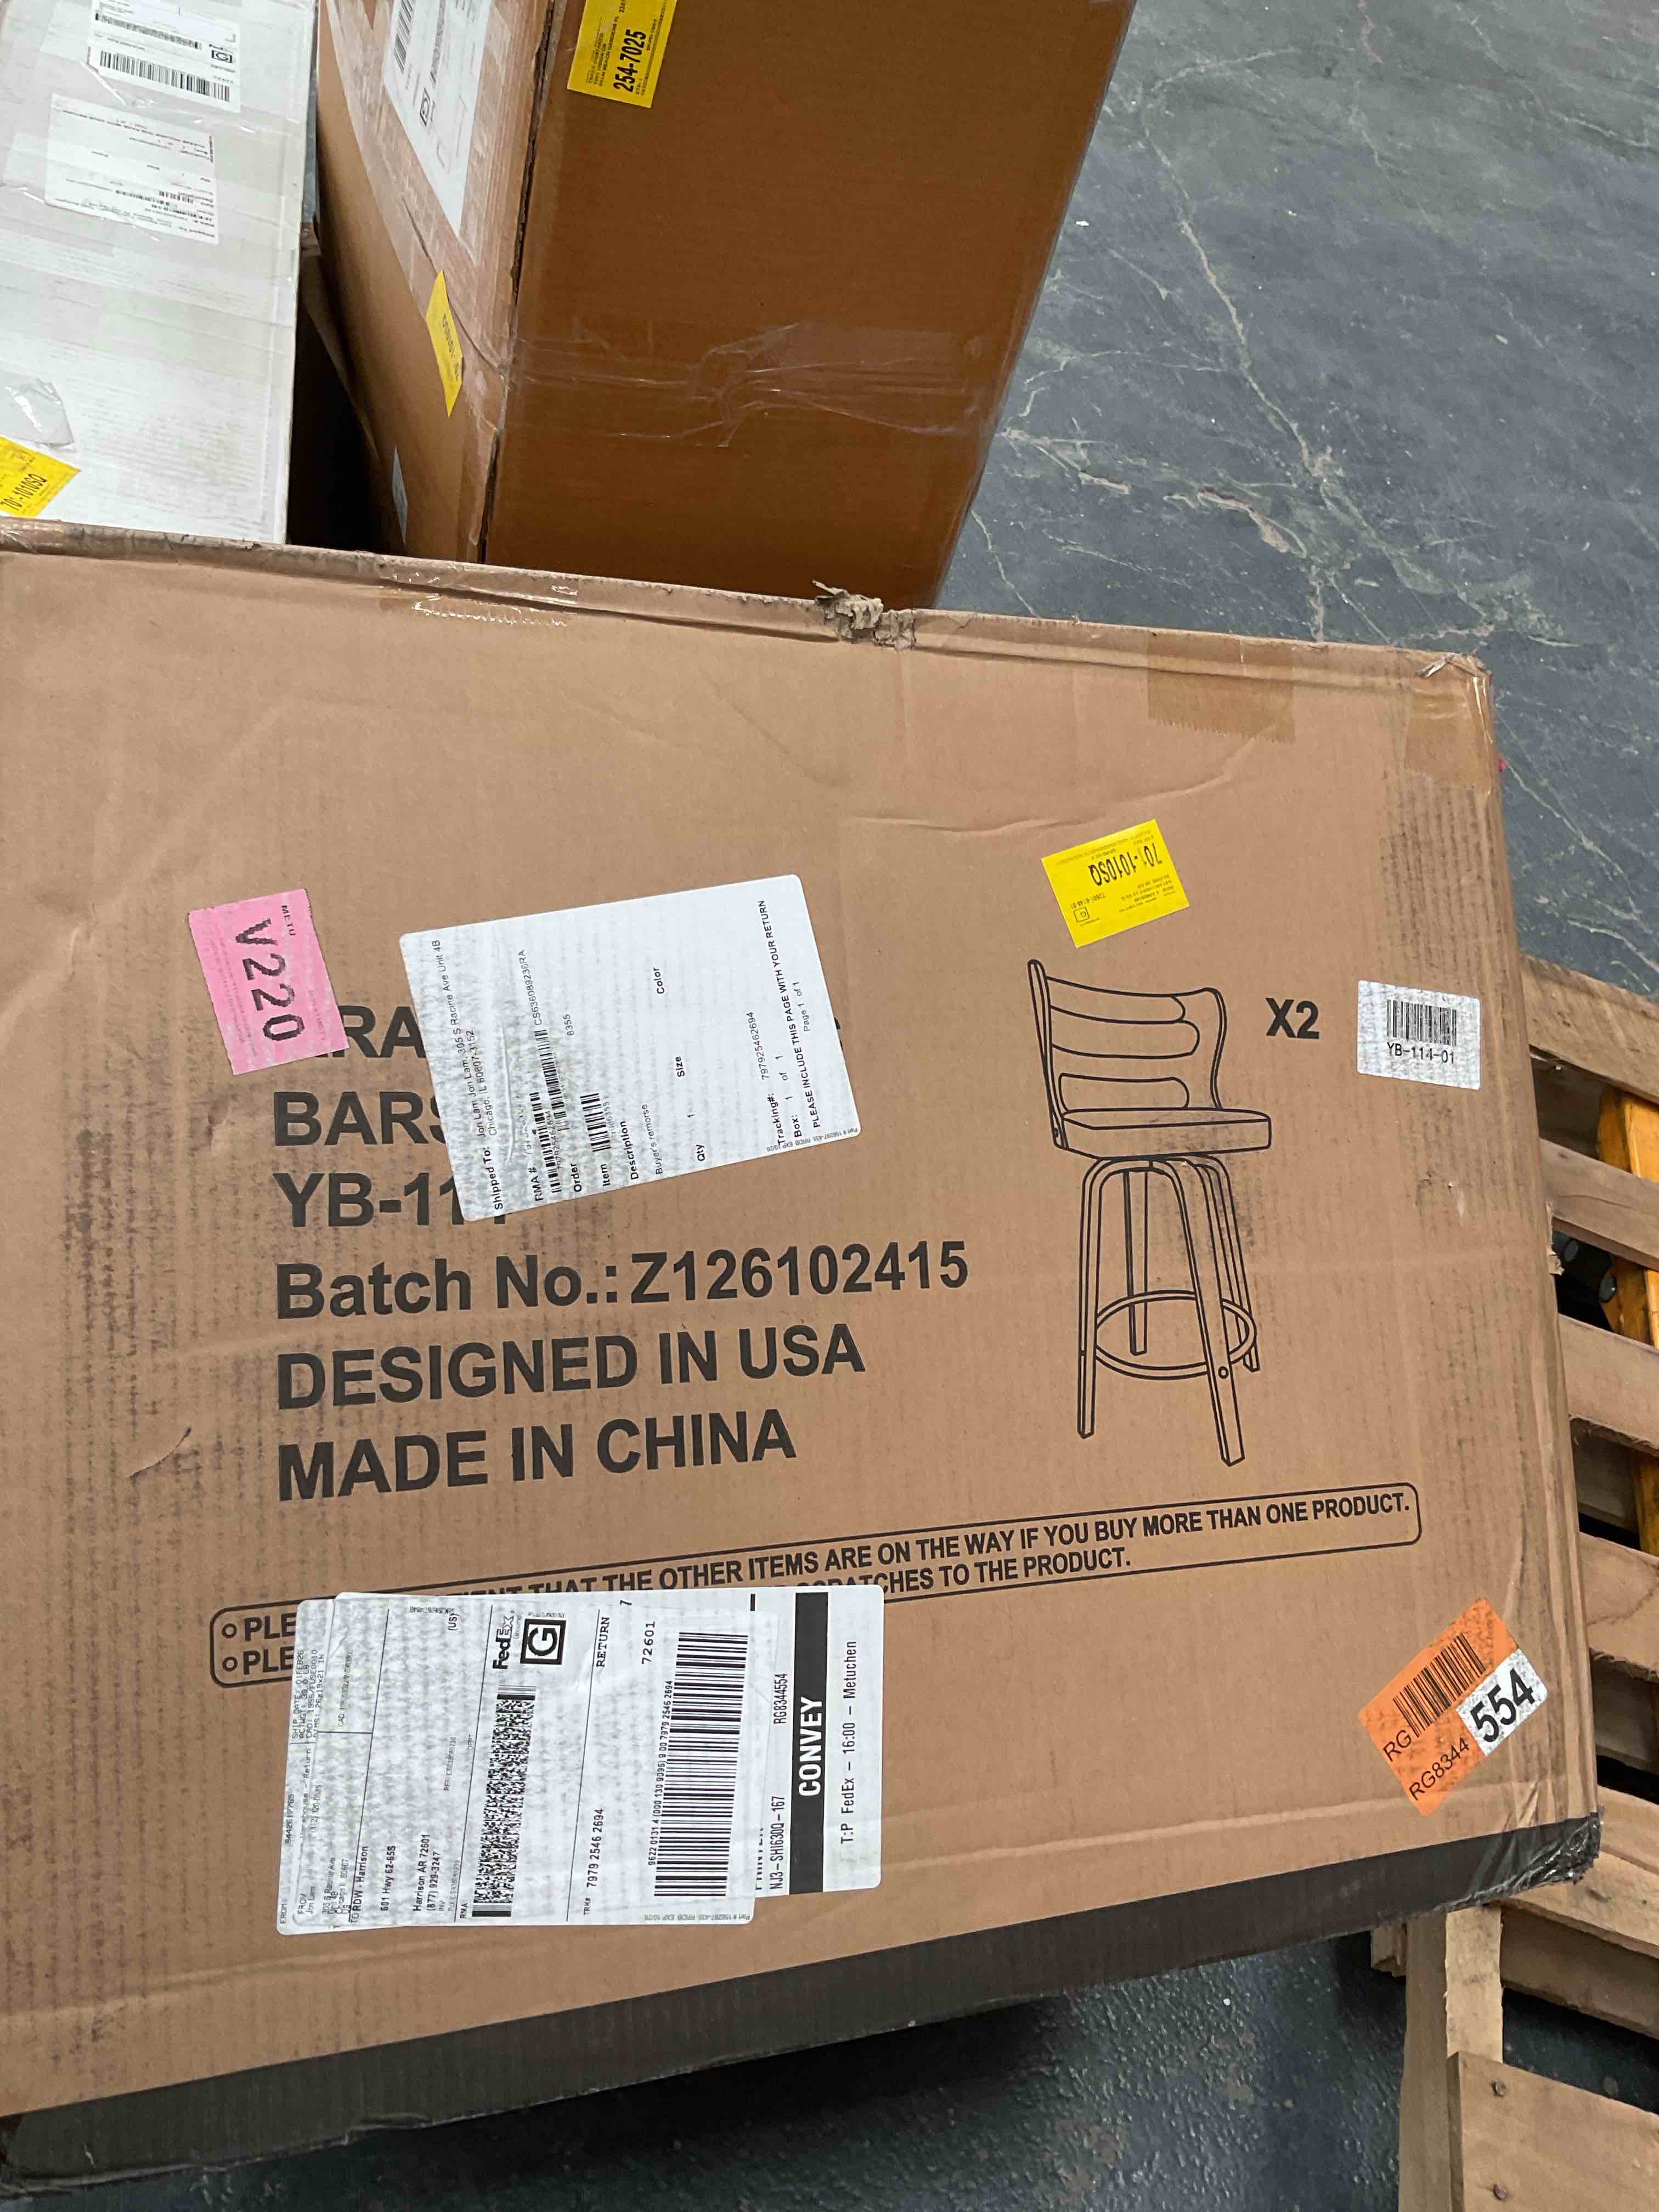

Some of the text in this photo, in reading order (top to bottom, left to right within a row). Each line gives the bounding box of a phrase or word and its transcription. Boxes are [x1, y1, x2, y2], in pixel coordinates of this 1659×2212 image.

[613, 29, 646, 92] 254-7025
[431, 939, 442, 952] 4B
[435, 953, 447, 972] Unit
[235, 918, 305, 1041] V220
[440, 974, 451, 992] Ave
[652, 966, 665, 995] Color
[793, 987, 803, 996] of
[446, 994, 459, 1025] Racine
[758, 900, 820, 1128] PLEASE INCLUDE THIS PAGE WITH YOUR RETURN
[800, 1009, 811, 1032] Page
[1266, 997, 1319, 1039] X2
[315, 1006, 426, 1058] RA
[455, 1037, 466, 1054] 305
[1387, 1042, 1454, 1063] YB-114-01
[518, 949, 582, 1192] Order CS636089236RA
[674, 1056, 685, 1077] Size
[747, 1011, 786, 1146] Tracking#: 797925462694
[778, 1071, 788, 1081] of
[465, 1080, 476, 1097] Jon
[466, 1030, 498, 1136] Chicago, IL 60607-3152
[470, 1099, 482, 1119] Lam
[475, 1121, 486, 1138] Jon
[791, 1114, 802, 1137] Box:
[618, 1120, 640, 1180] Description
[641, 1104, 664, 1175] Buyer's remorse
[480, 1146, 492, 1164] To:
[695, 1143, 706, 1162] Qty
[599, 1163, 611, 1187] Item
[486, 1166, 505, 1210] Shipped
[531, 1176, 543, 1201] RMA
[277, 1259, 471, 1318] Batch
[278, 1323, 865, 1409] DESIGNED IN USA
[279, 1408, 796, 1501] MADE IN CHINA
[603, 1570, 653, 1591] THE
[659, 1559, 742, 1590] OTHER
[749, 1551, 818, 1580] ITEMS
[825, 1546, 872, 1571] ARE
[878, 1541, 911, 1565] ON
[915, 1537, 960, 1560] THE
[964, 1530, 1014, 1555] WAY
[1020, 1529, 1037, 1549] IF
[1044, 1522, 1088, 1546] YOU
[1097, 1518, 1136, 1542] BUY
[1143, 1511, 1203, 1536] MORE
[1207, 1506, 1261, 1530] THAN
[1267, 1502, 1307, 1524] ONE
[1313, 1493, 1409, 1520] PRODUCT.
[939, 1564, 969, 1587] TO
[974, 1559, 1018, 1583] THE
[1024, 1548, 1131, 1578] PRODUCT.
[447, 1612, 459, 1630] (US)
[493, 1616, 513, 1669] FedEx
[527, 1627, 558, 1656] G
[596, 1616, 610, 1667] RETURN
[641, 1620, 655, 1663] 72601
[295, 1650, 304, 1684] 01FEB26
[844, 1641, 856, 1699] Metuchen
[663, 1680, 672, 1697] 2694
[774, 1673, 787, 1724] RG8344554
[662, 1701, 670, 1718] 2546
[1471, 1668, 1535, 1743] 554
[660, 1721, 669, 1739] 7979
[843, 1722, 855, 1754] 16:00
[659, 1742, 667, 1751] 00
[799, 1695, 823, 1795] CONVEY
[1383, 1730, 1412, 1762] RG
[656, 1759, 667, 1781] 9096)
[1409, 1737, 1469, 1801] RG8344
[654, 1784, 663, 1797] 130
[842, 1777, 854, 1813] FedEx
[592, 1808, 603, 1832] 2694
[653, 1800, 662, 1816] (000
[650, 1826, 658, 1844] 0131
[841, 1822, 853, 1843] T:P
[590, 1836, 601, 1860] 2546
[648, 1846, 657, 1865] 9622
[356, 1847, 368, 1882] Harrison
[413, 1833, 430, 1911] Harrison AR 72601
[586, 1863, 599, 1887] 7979
[382, 1876, 394, 1893] Hwy
[352, 1890, 363, 1911] RDW
[380, 1897, 389, 1911] 601
[426, 1890, 438, 1911] (877)
[459, 1903, 468, 1918] RMA
